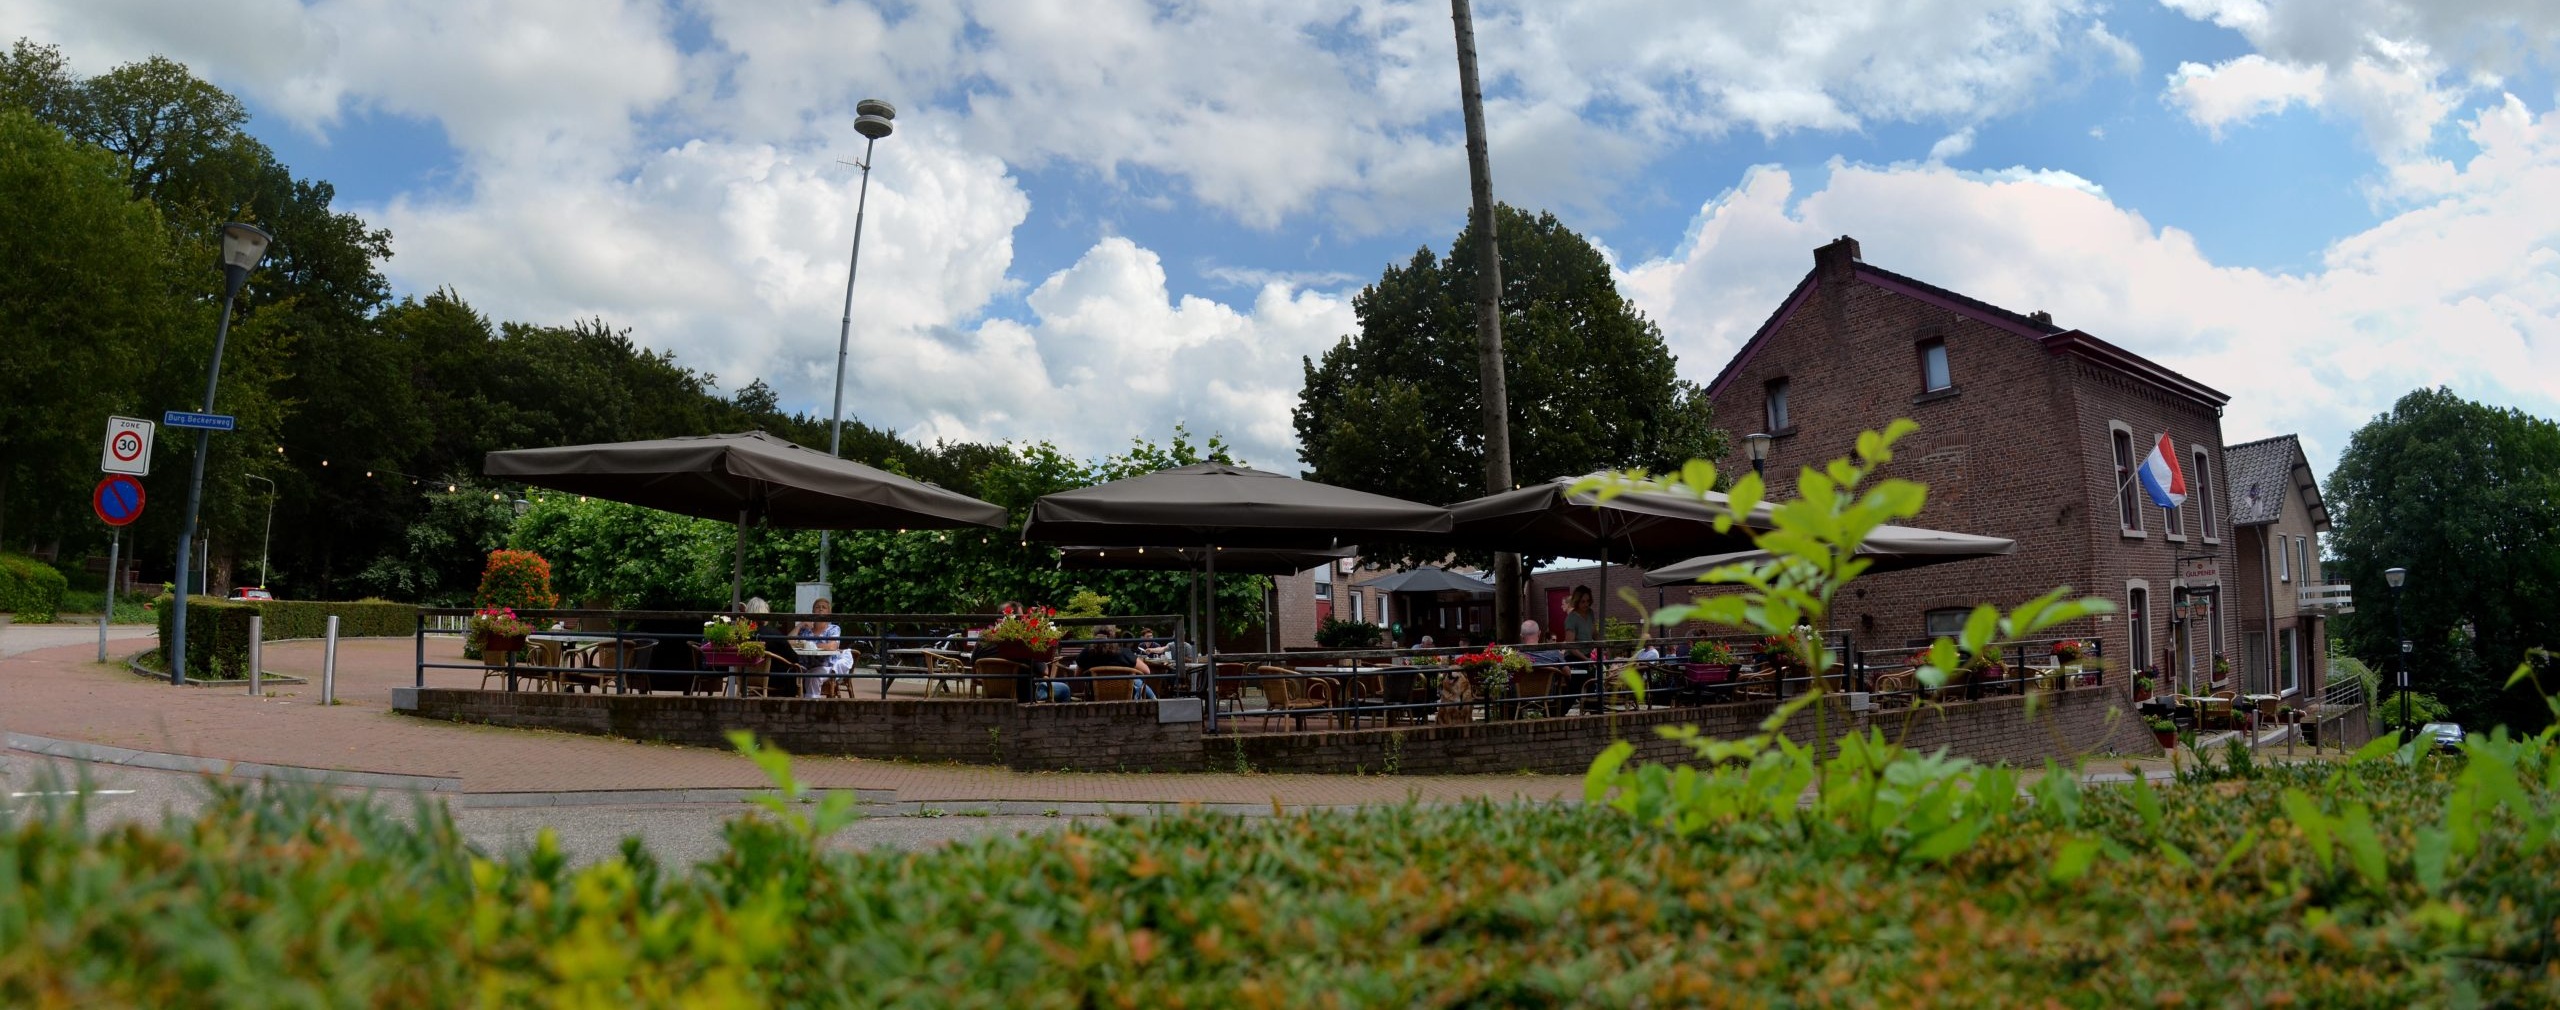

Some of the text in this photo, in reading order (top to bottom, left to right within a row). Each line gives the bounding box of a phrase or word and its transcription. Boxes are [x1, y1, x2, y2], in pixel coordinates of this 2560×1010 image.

[120, 421, 140, 429] ZONE
[187, 415, 230, 427] Beckersweg
[118, 439, 136, 451] 30
[2186, 569, 2215, 577] GULPENER
